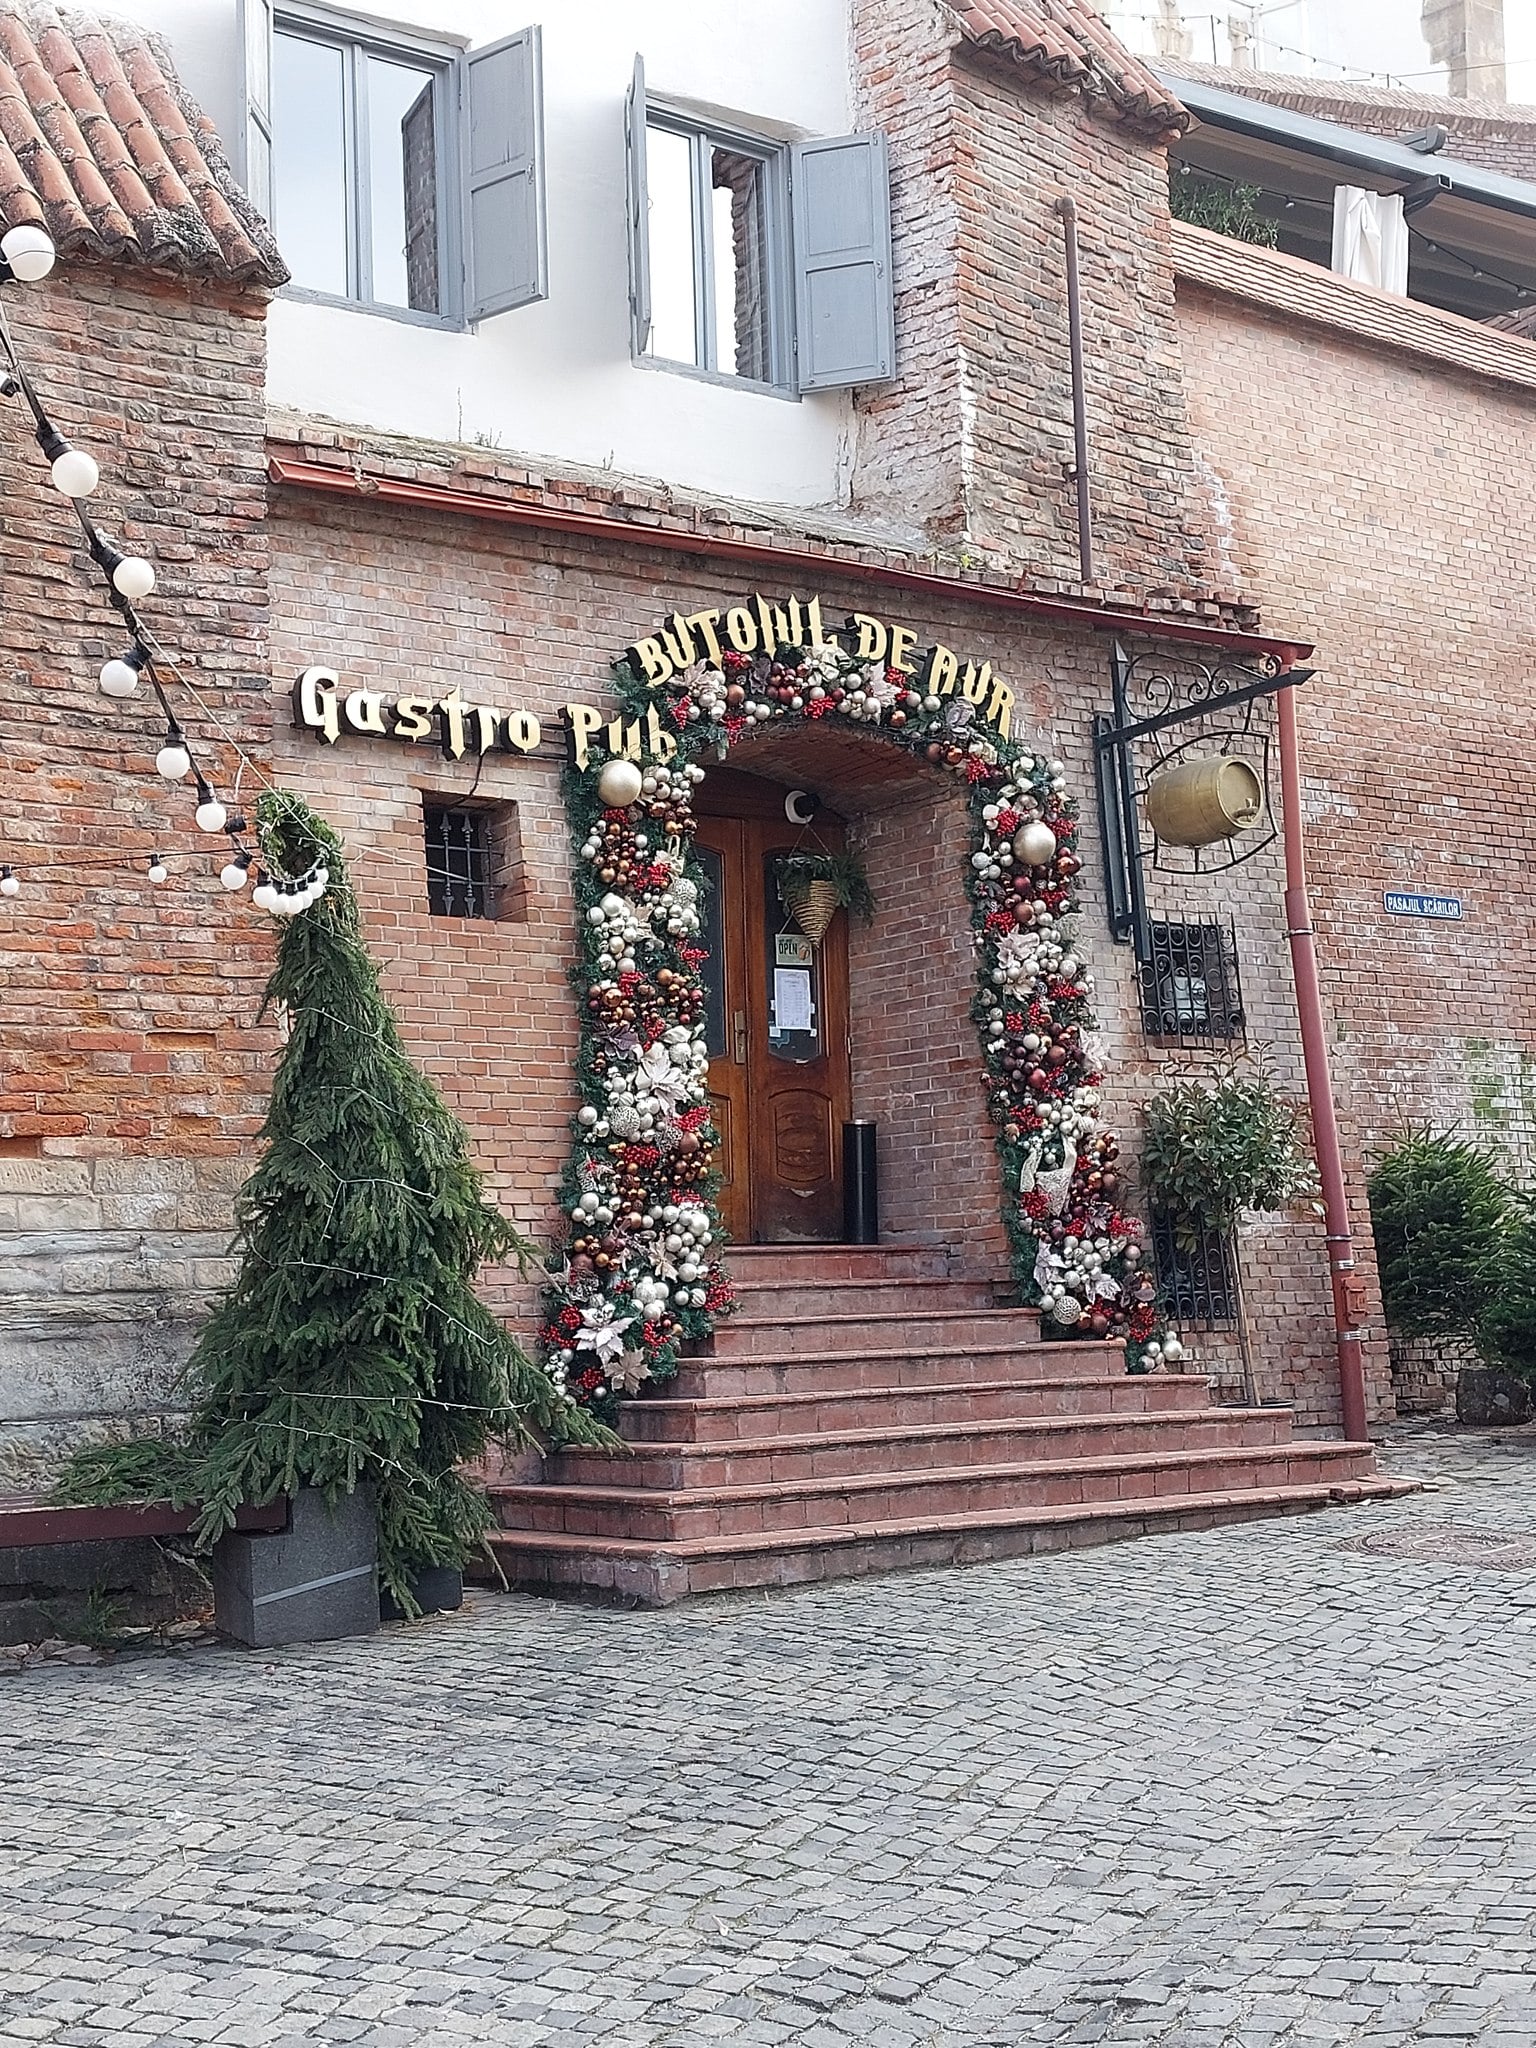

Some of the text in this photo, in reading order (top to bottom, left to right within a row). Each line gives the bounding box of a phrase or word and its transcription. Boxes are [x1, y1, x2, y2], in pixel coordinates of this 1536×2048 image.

[300, 665, 677, 773] Gastro Pub
[634, 591, 1016, 745] BUTOIUL DE AUR
[1387, 895, 1421, 913] PASAJUL
